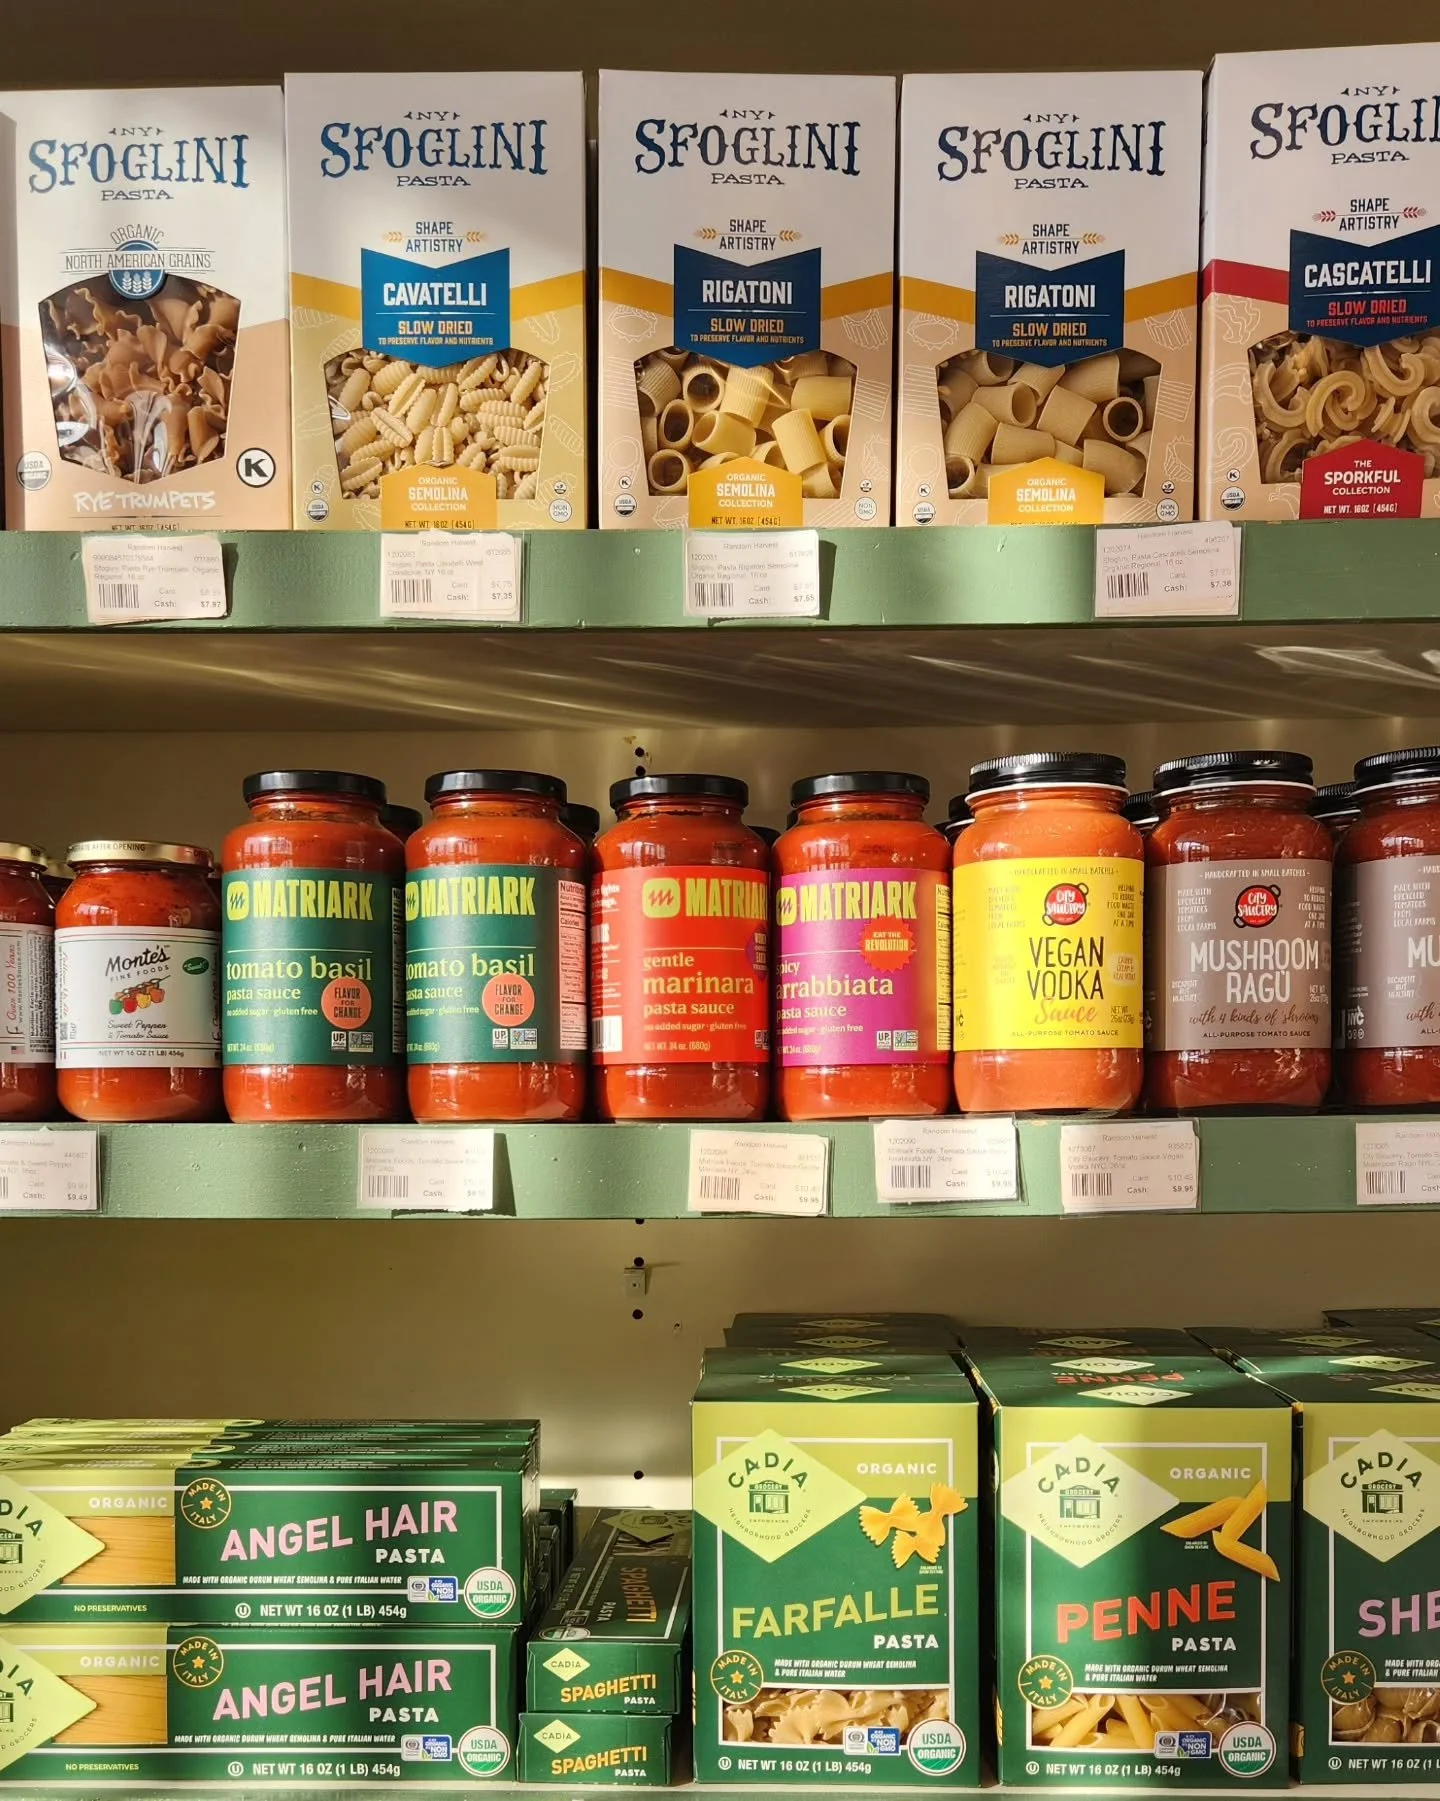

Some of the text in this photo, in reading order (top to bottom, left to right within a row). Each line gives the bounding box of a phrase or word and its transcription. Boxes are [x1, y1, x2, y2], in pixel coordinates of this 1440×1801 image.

[320, 119, 548, 178] SFOGLINI
[635, 119, 861, 176] SFOGLINI
[937, 121, 1166, 181] SFOGLINI
[28, 134, 249, 193] SFOGLINI
[396, 176, 471, 187] PASTA
[101, 190, 174, 201] PASTA
[1350, 198, 1390, 213] SHAPE
[729, 219, 766, 233] SHAPE
[1338, 215, 1400, 232] ARTISTRY
[110, 223, 164, 246] ORGANIC
[719, 237, 776, 251] ARTISTRY
[66, 253, 211, 270] NORTH AMERICAN GRAINS
[1304, 259, 1432, 288] CASCATELLI
[384, 282, 487, 306] CAVATELLI
[702, 280, 792, 304] RIGATONI
[1004, 284, 1096, 308] RIGATONI
[1328, 298, 1407, 316] SLOW DRIED
[398, 320, 472, 335] SLOW DRIED
[710, 318, 784, 333] SLOW DRIED
[690, 334, 804, 344] TO PRESERVE FLAVOR AND NUTRIENTS
[1354, 460, 1372, 468] THE
[418, 477, 458, 486] ORGANIC
[726, 474, 766, 482] ORGANIC
[1324, 470, 1401, 486] SPORKFUL
[408, 487, 468, 500] SEMOLINA
[716, 484, 776, 498] SEMOLINA
[1332, 486, 1391, 496] COLLECTION
[73, 490, 216, 512] RYE TRUMPETS
[411, 503, 466, 512] COLLECTION
[718, 500, 773, 508] COLLECTION
[1324, 504, 1337, 514] NET
[112, 842, 146, 852] OPENING
[253, 880, 374, 920] MATRIARK
[420, 876, 536, 918] MATRIARK
[800, 880, 917, 922] MATRIARK
[1247, 892, 1267, 905] CITY
[1238, 904, 1278, 918] SAUCERY
[865, 939, 908, 952] REVOLUTION
[1028, 936, 1104, 968] VEGAN
[105, 945, 170, 977] Monte's
[642, 952, 695, 970] gentle
[1190, 938, 1319, 972] MUSHROOM
[110, 964, 170, 982] FINE FOODS
[226, 954, 372, 980] tomato basil
[776, 960, 800, 976] spicy
[642, 972, 754, 994] marinara
[776, 974, 894, 1000] arrabbiata
[1026, 970, 1104, 1000] VODKA
[226, 988, 301, 1004] pasta sauce
[334, 987, 361, 1000] FLAVOR
[334, 1006, 362, 1019] CHANGE
[643, 1002, 734, 1018] pasta sauce
[776, 1005, 846, 1023] pasta sauce
[1034, 996, 1098, 1026] Sauce
[1189, 1006, 1215, 1025] with
[1264, 1009, 1278, 1025] of
[108, 1019, 168, 1032] Sweet Pepper
[654, 1022, 680, 1030] added
[682, 1023, 705, 1032] sugar
[709, 1022, 734, 1032] gluten
[146, 1030, 169, 1038] Sauce
[67, 1194, 88, 1202] $9.49
[728, 1452, 808, 1490] CADIA
[856, 1462, 938, 1476] ORGANIC
[1037, 1456, 1121, 1494] CADIA
[1340, 1452, 1423, 1489] CADIA
[188, 1482, 226, 1502] MADE IN
[89, 1497, 168, 1510] ORGANIC
[190, 1511, 217, 1526] ITALY
[220, 1500, 458, 1562] ANGEL HAIR
[376, 1548, 445, 1564] PASTA
[182, 1576, 201, 1584] MADE
[202, 1576, 219, 1584] WITH
[220, 1576, 248, 1584] ORGANIC
[249, 1576, 272, 1584] DURUM
[274, 1576, 295, 1584] WHEAT
[296, 1576, 328, 1584] SEMOLINA
[336, 1576, 352, 1584] PURE
[354, 1576, 376, 1584] ITALIAN
[377, 1576, 402, 1584] WATER
[477, 1580, 504, 1592] USDA
[473, 1594, 507, 1604] ORGANIC
[87, 1604, 148, 1612] PRESERVATIVES
[260, 1605, 407, 1619] NET WT 16 OZ (1 LB) 454g
[732, 1583, 939, 1640] FARFALLE
[1056, 1580, 1236, 1644] PENNE
[874, 1634, 939, 1648] PASTA
[1172, 1637, 1237, 1652] PASTA
[550, 1660, 582, 1668] CADIA
[560, 1672, 657, 1704] SPAGHETTI
[624, 1696, 656, 1705] PASTA
[922, 1733, 952, 1745] USDA
[918, 1749, 956, 1760] ORGANIC
